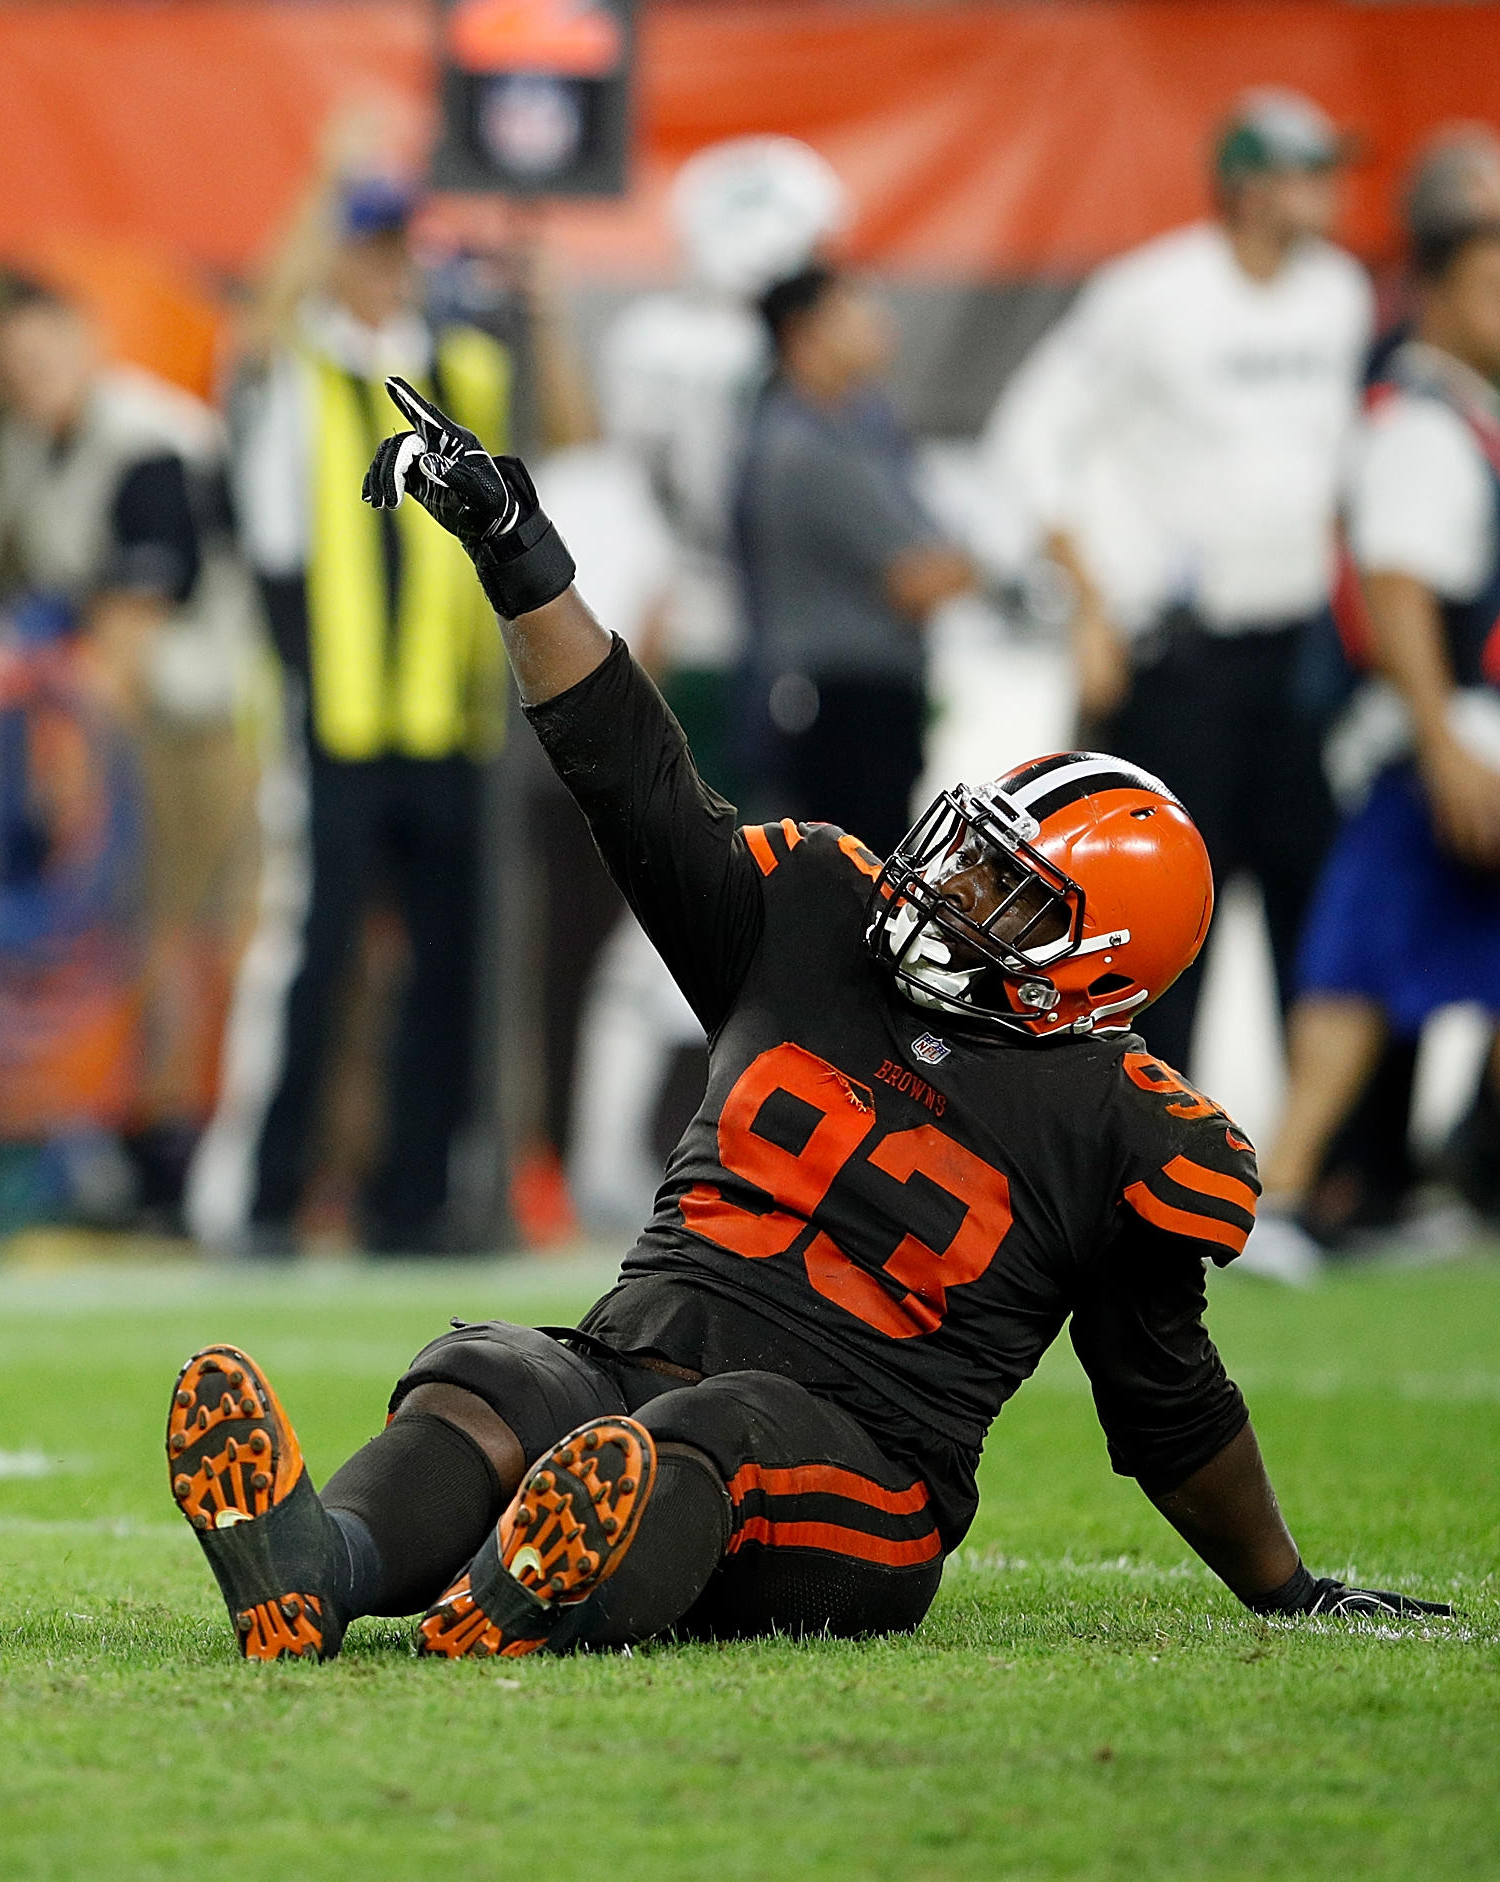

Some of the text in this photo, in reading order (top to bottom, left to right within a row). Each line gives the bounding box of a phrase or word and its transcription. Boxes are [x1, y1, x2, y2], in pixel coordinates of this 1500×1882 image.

[915, 1040, 938, 1060] NFL
[873, 1058, 949, 1118] BROWNS
[1122, 1052, 1238, 1127] 9
[678, 1041, 1014, 1339] 93
